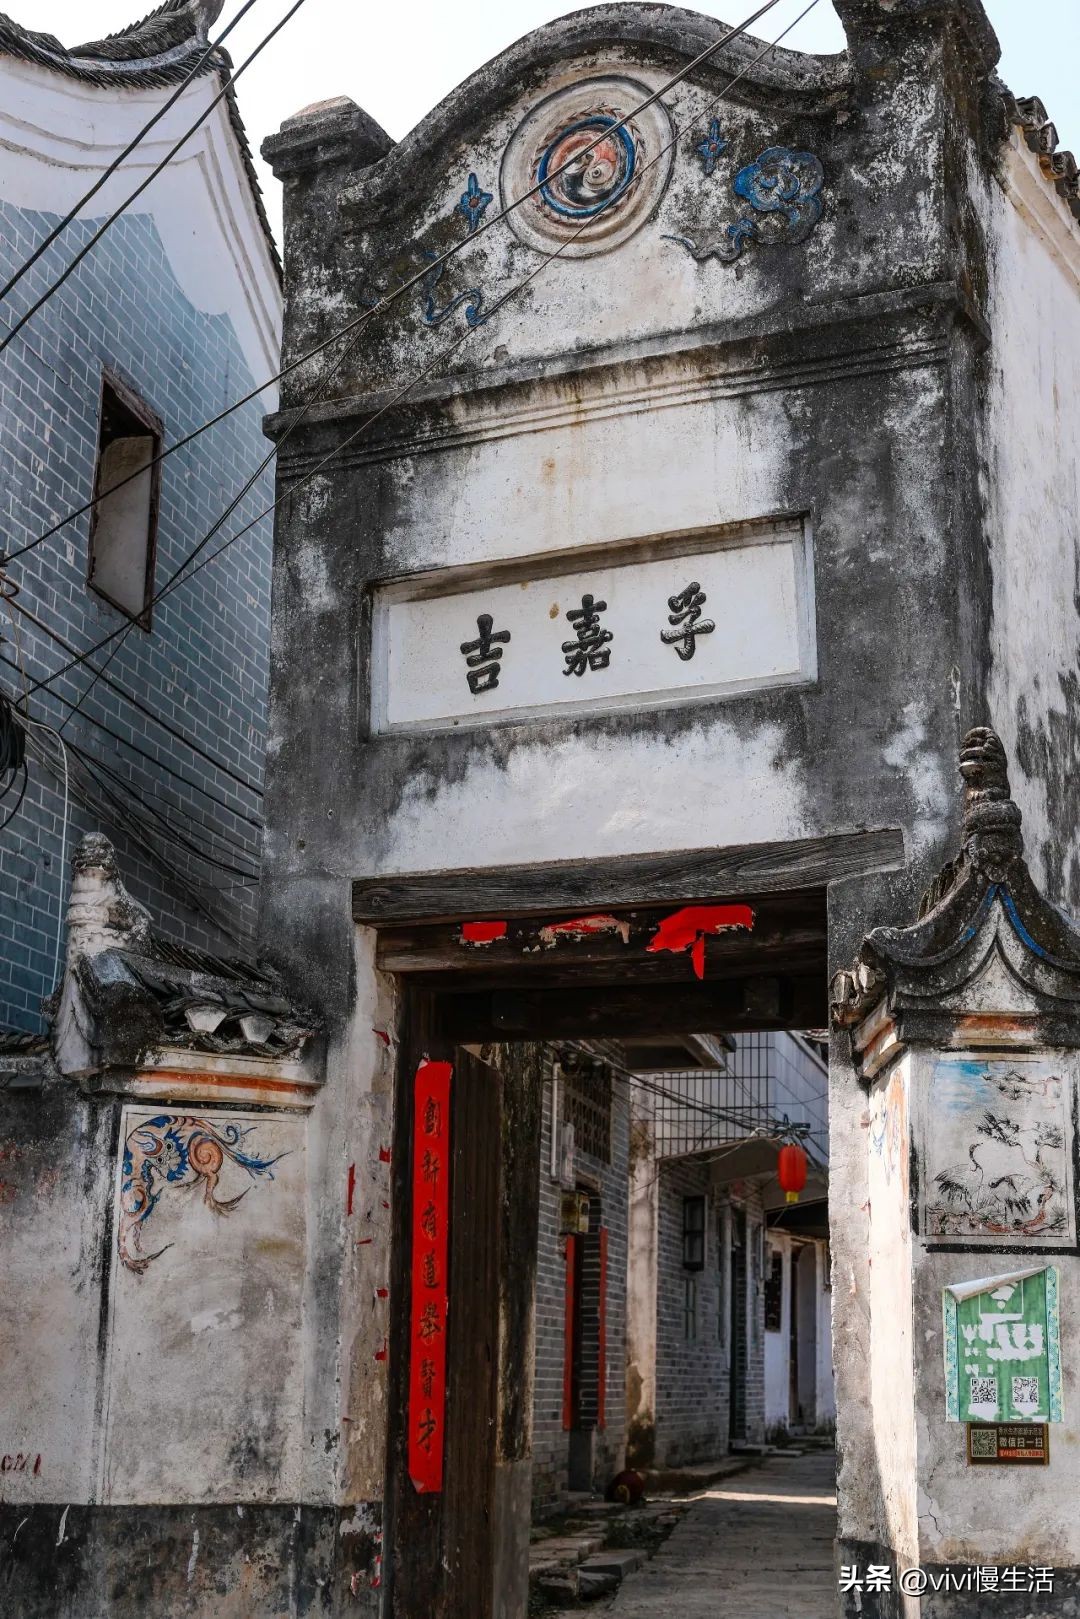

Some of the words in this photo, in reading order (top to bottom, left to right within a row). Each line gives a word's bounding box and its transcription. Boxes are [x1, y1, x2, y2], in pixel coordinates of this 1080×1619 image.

[999, 1437, 1043, 1448] 微信扫一扫
